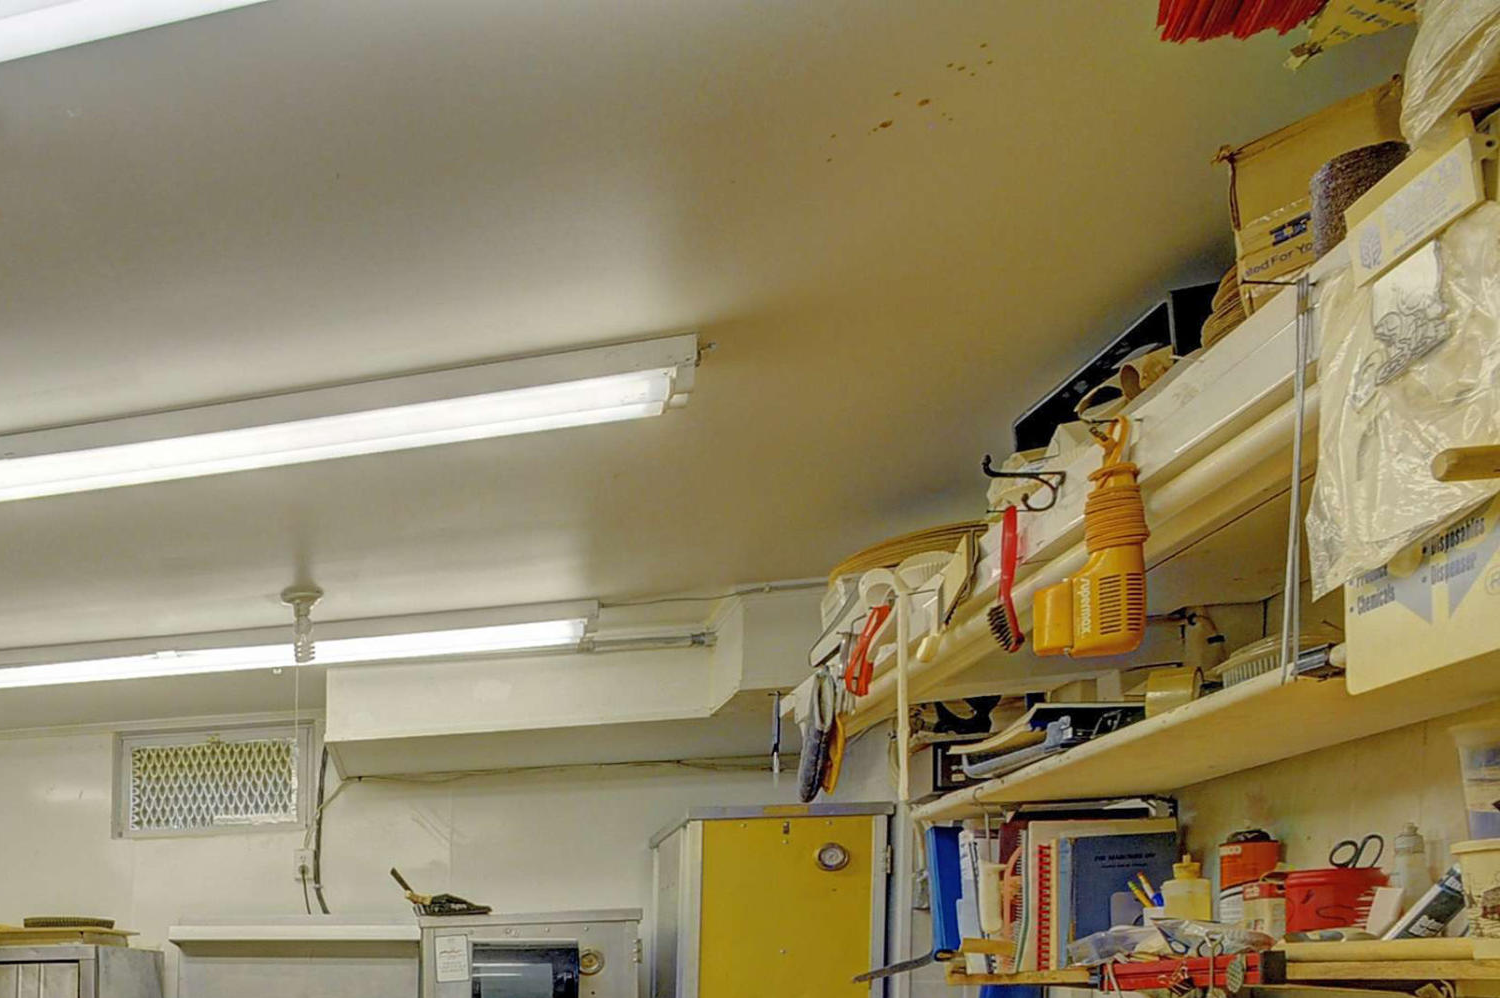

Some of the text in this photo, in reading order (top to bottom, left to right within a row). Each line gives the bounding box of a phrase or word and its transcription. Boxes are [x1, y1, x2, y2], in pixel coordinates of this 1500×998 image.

[1271, 250, 1293, 265] For
[1296, 242, 1313, 254] Yo
[1430, 552, 1477, 585] Dispenser
[1357, 583, 1396, 616] Chemicals
